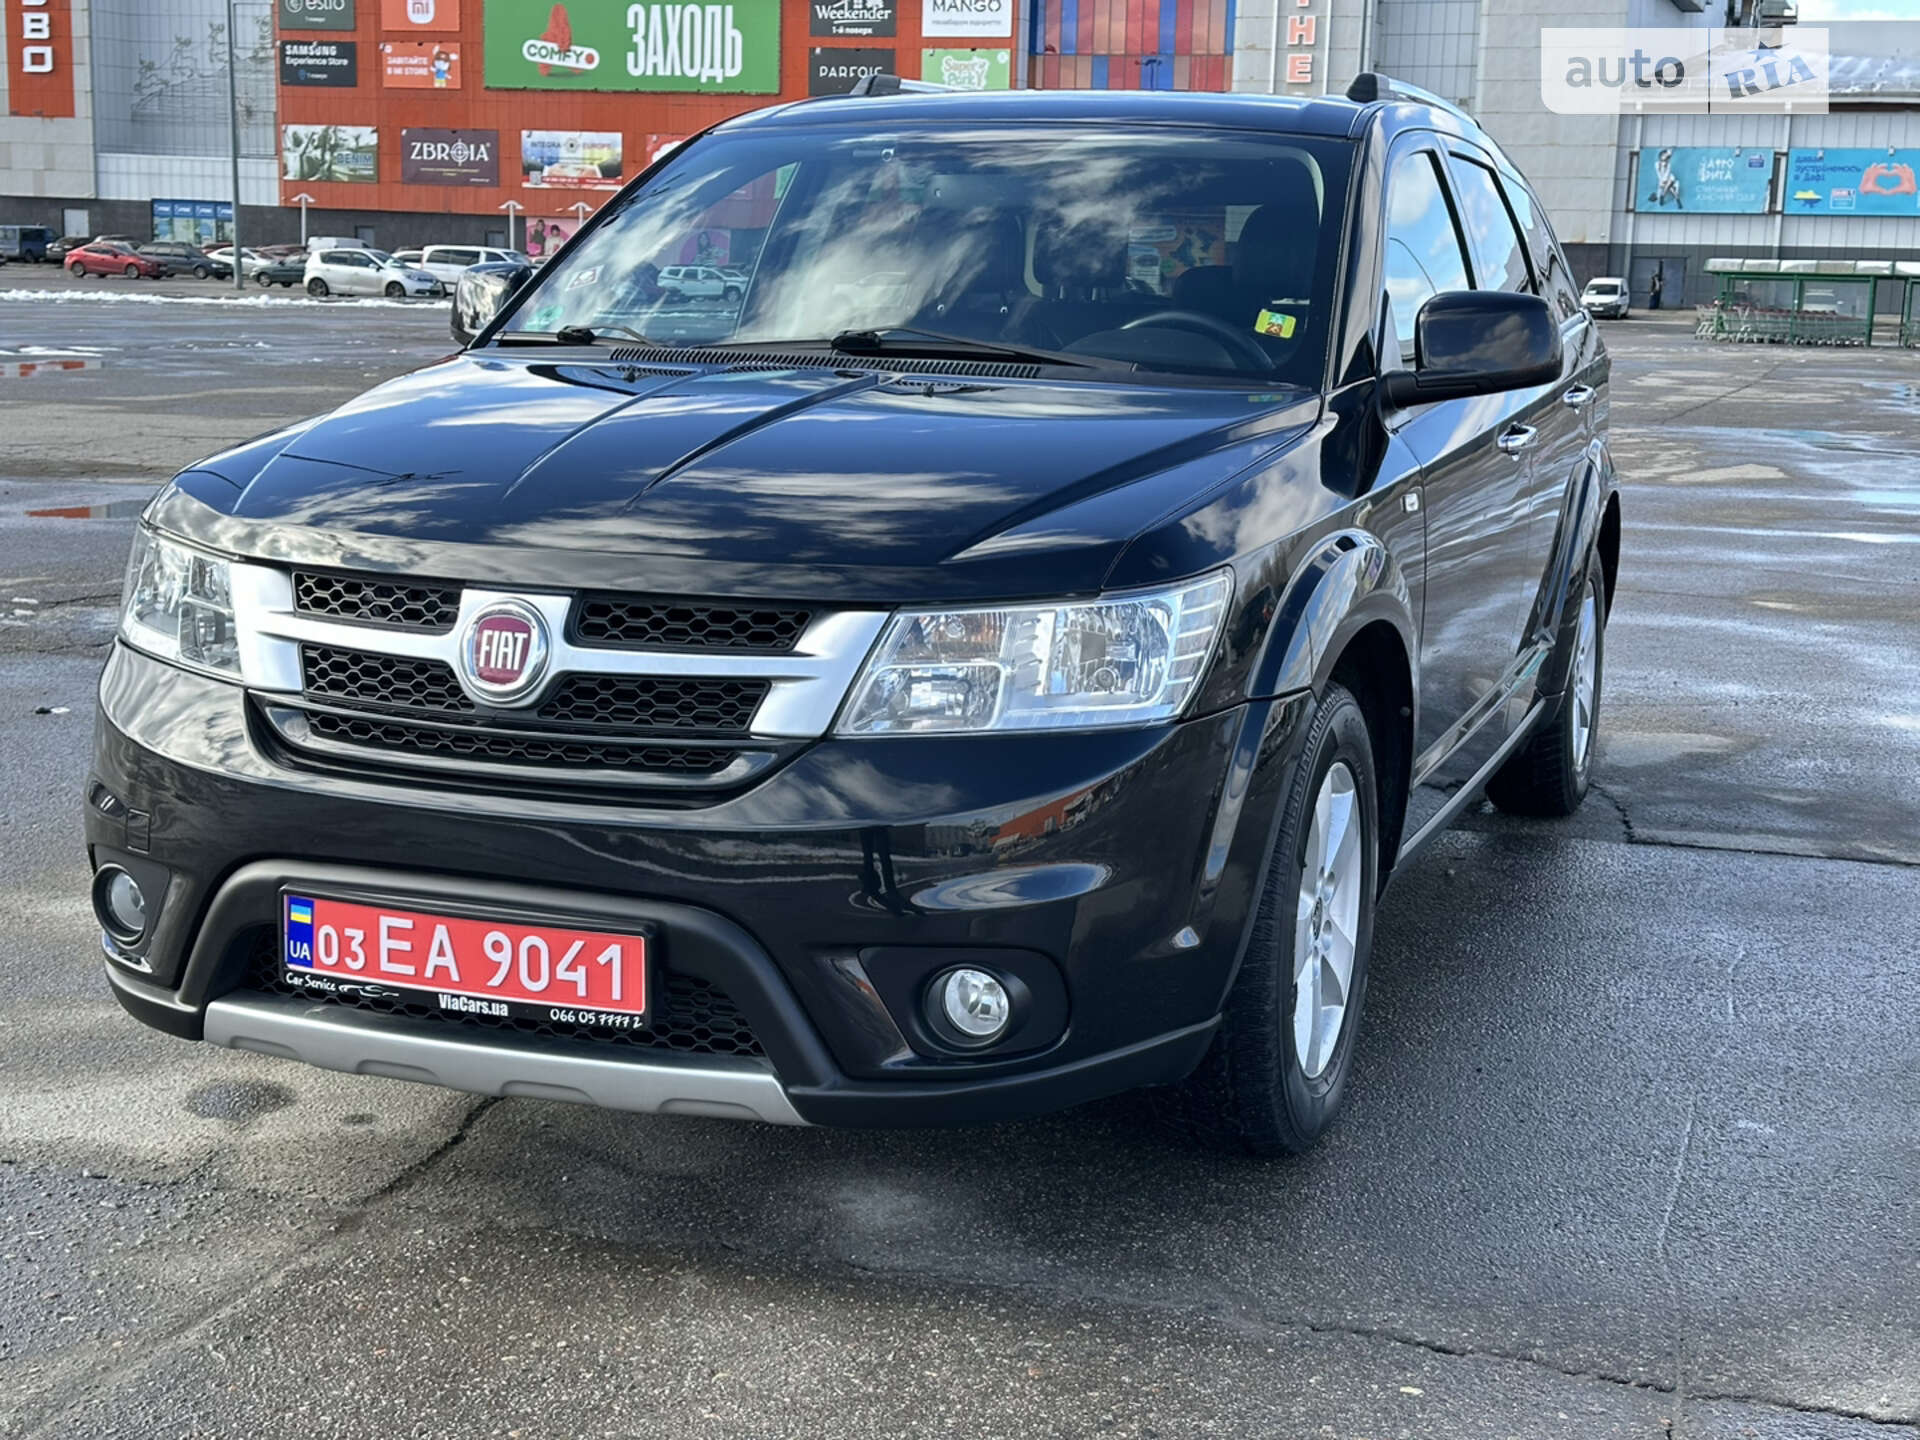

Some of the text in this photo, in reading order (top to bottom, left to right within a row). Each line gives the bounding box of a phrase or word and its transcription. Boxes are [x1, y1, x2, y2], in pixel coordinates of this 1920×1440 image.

[815, 5, 892, 20] Weekender
[932, 0, 1002, 12] MANGO
[285, 44, 337, 56] SAMSUNG
[526, 43, 584, 64] COMFY
[626, 3, 743, 84] ЗАХОДЬ
[480, 629, 529, 671] FIAT
[289, 940, 311, 960] UA
[317, 914, 623, 1001] 03 EA 9041
[285, 971, 336, 991] Car Service
[438, 993, 509, 1017] ViaCars.ua
[550, 1008, 576, 1023] 066
[578, 1010, 597, 1024] 05
[599, 1013, 630, 1028] 7777
